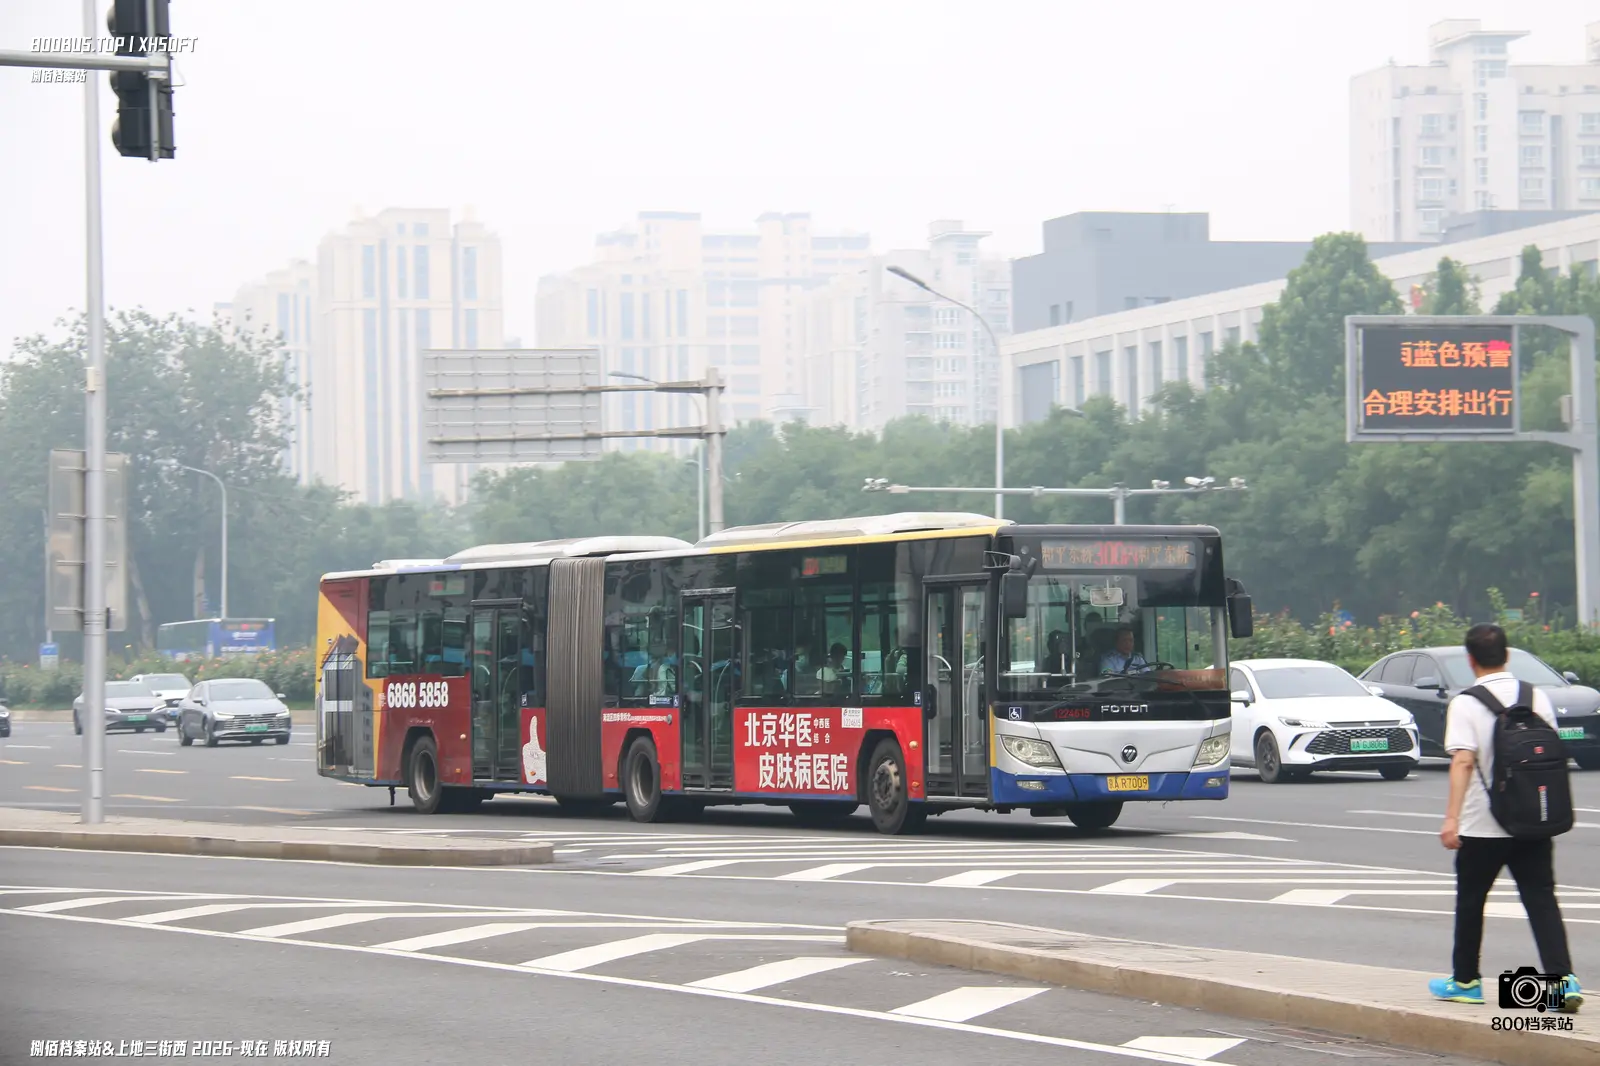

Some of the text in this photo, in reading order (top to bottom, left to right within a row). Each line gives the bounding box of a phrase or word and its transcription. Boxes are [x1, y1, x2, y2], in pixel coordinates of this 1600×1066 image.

[1363, 389, 1513, 416] 合理安排出行
[387, 682, 416, 708] 6868
[419, 681, 449, 708] 5858
[1101, 704, 1149, 713] FOTON
[744, 712, 813, 748] 北京华医
[814, 717, 830, 729] 中西医
[758, 752, 849, 791] 皮肤病医院
